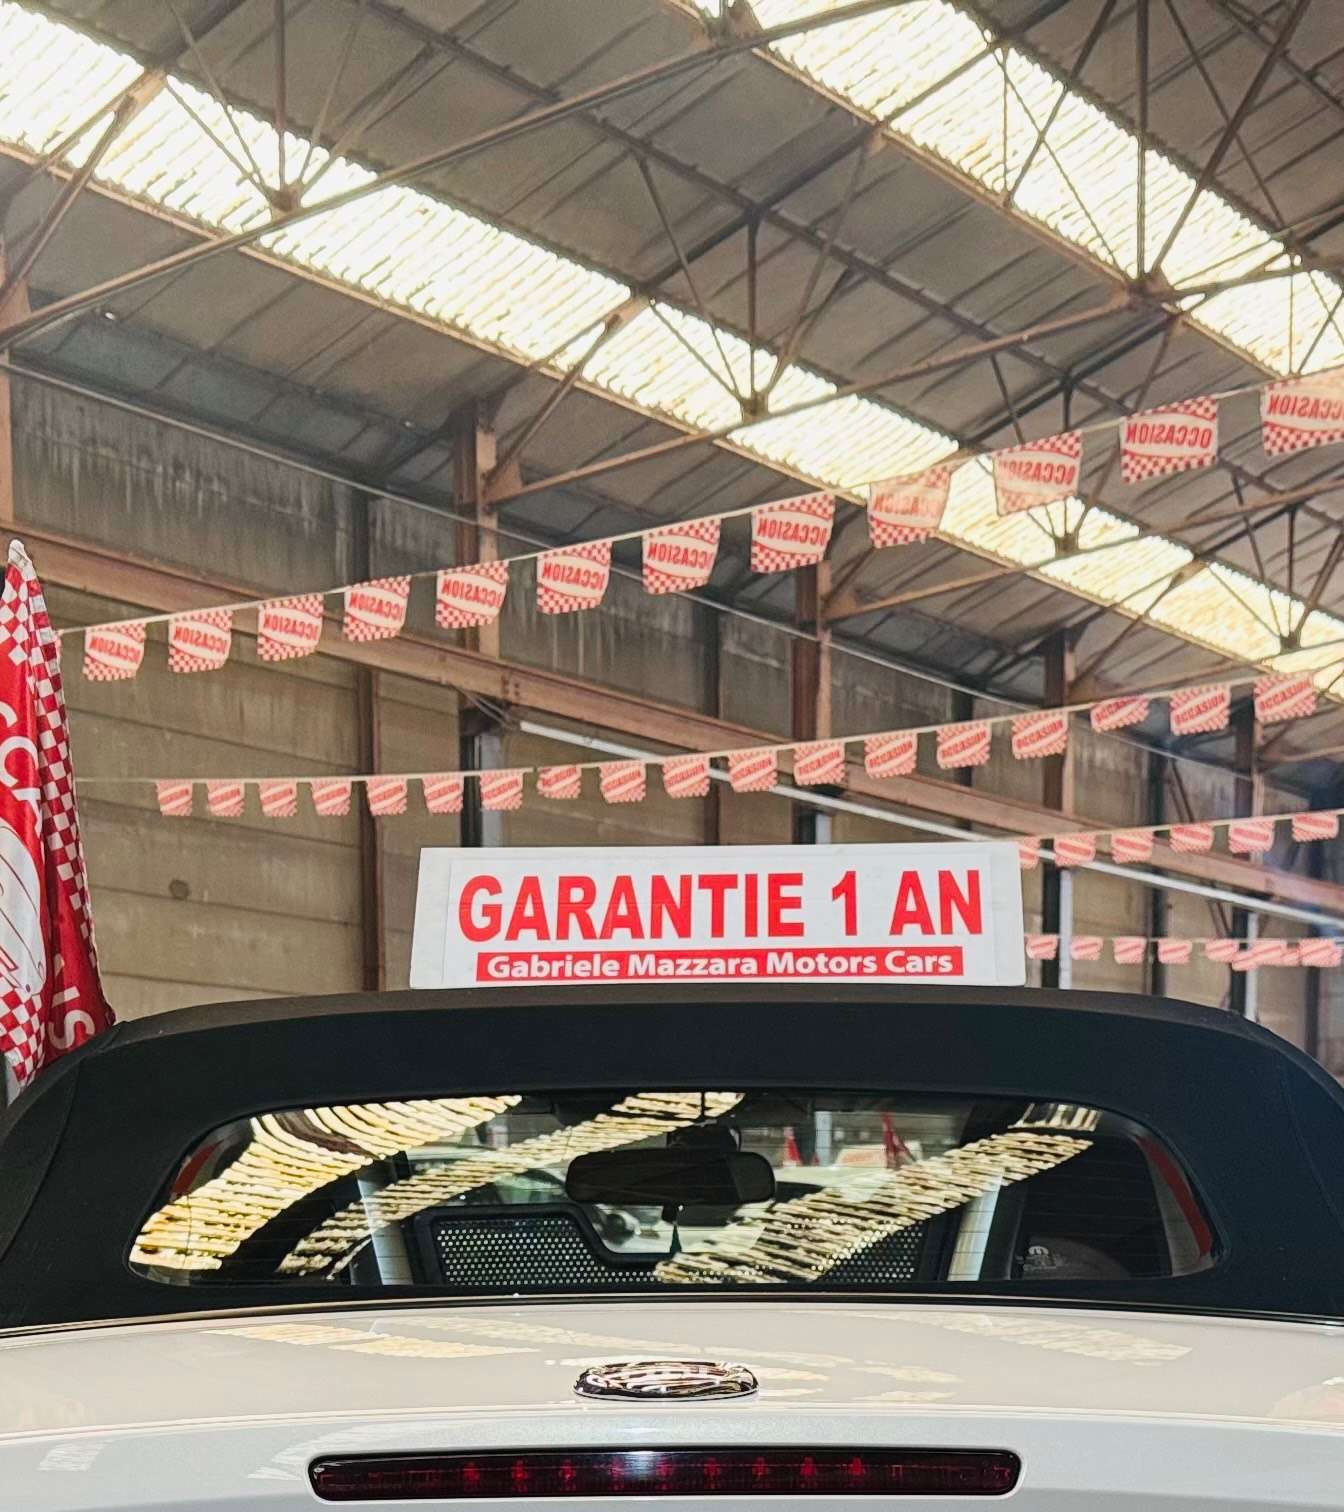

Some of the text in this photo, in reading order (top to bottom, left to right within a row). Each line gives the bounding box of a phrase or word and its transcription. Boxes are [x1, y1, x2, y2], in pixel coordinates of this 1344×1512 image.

[458, 869, 984, 942] GARANTIE 1 AN
[487, 949, 954, 979] Gabriele Mazzara Motors Cars
